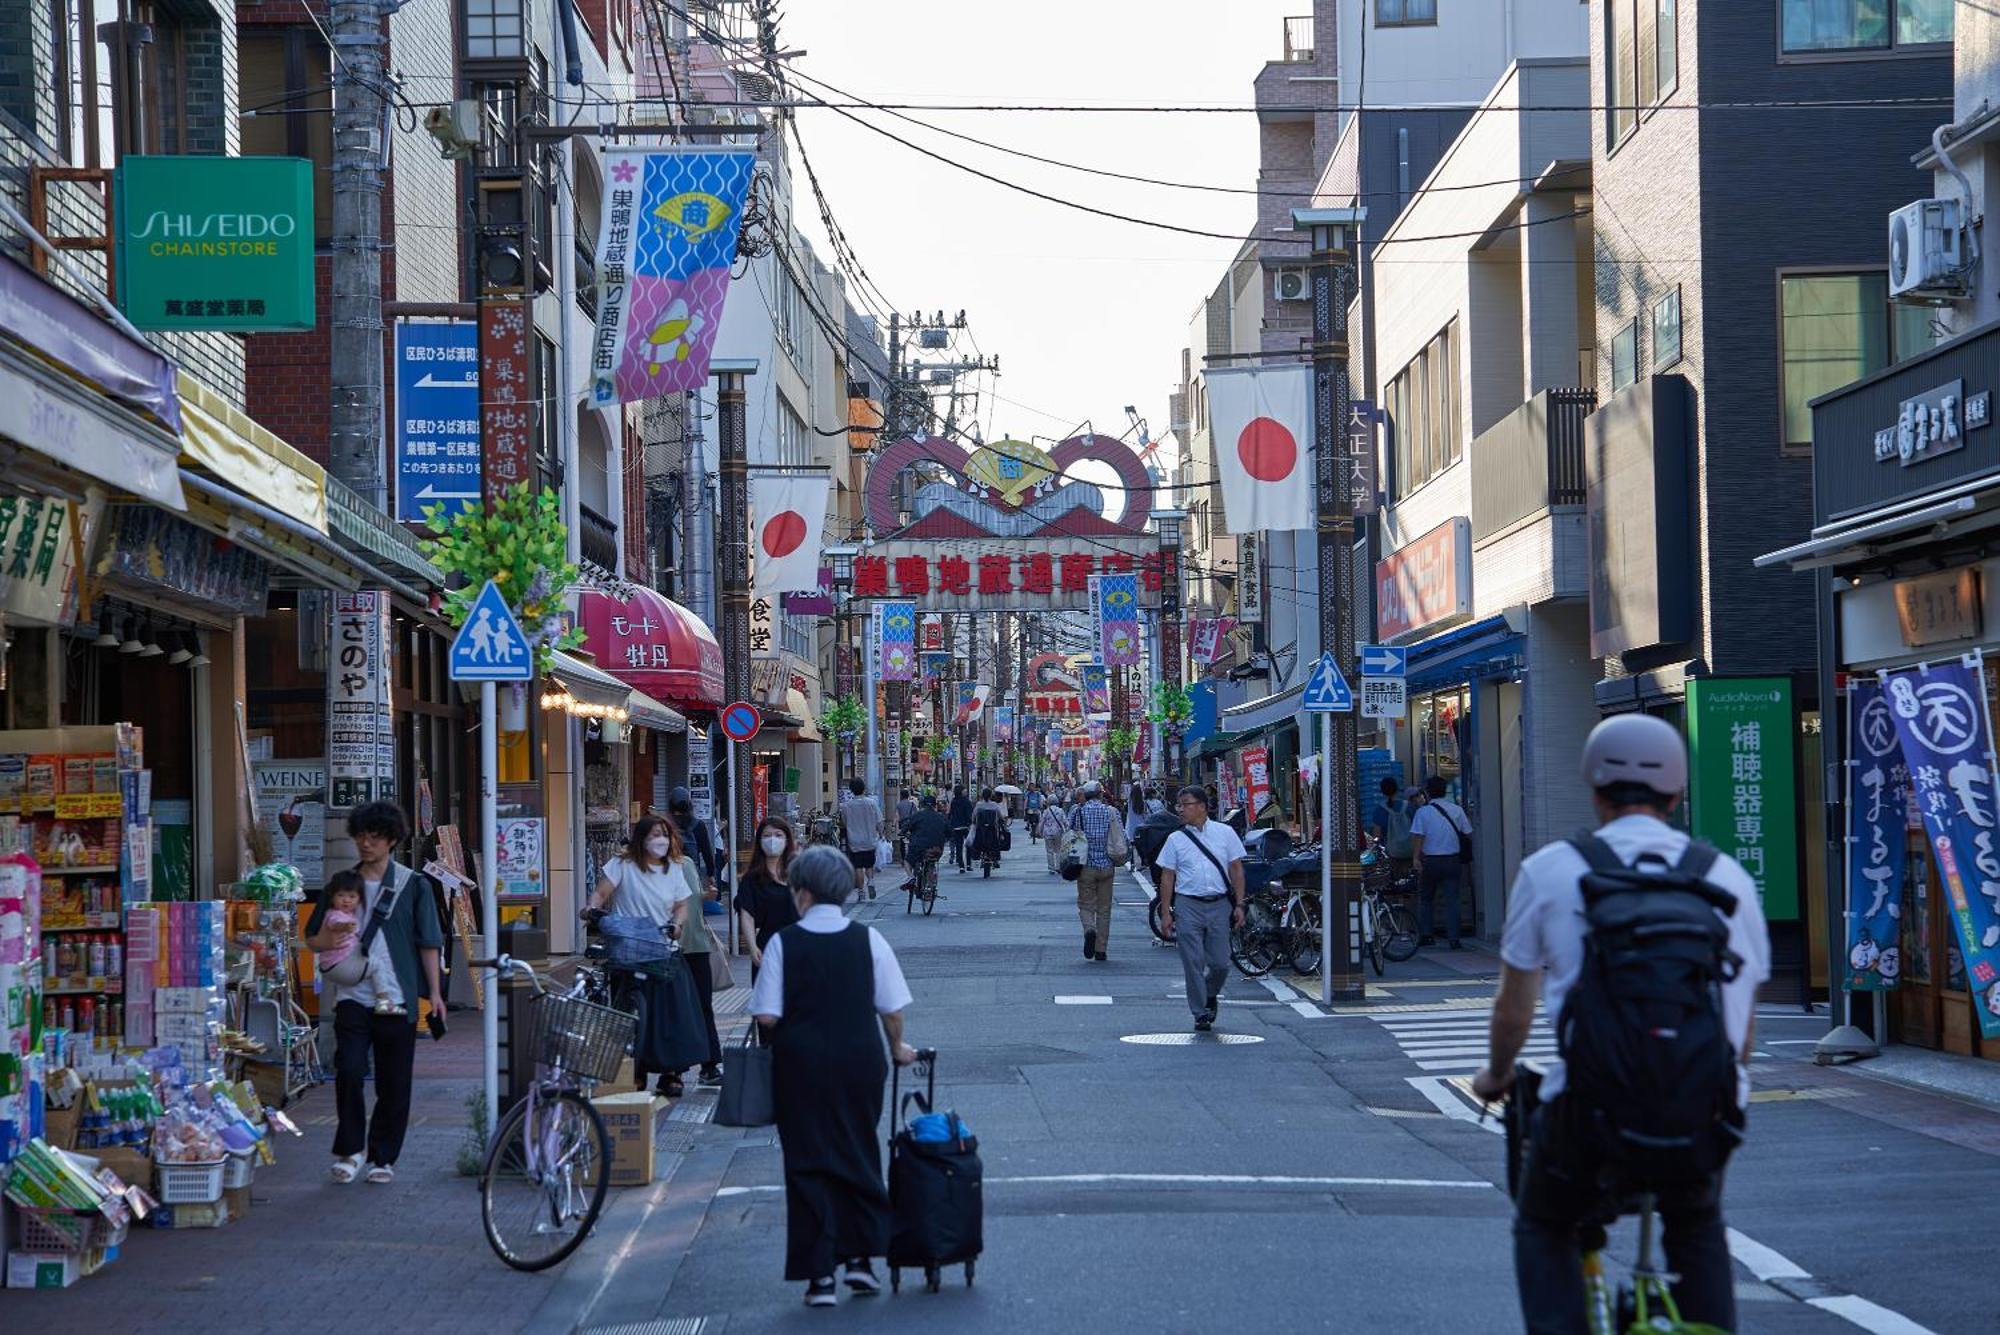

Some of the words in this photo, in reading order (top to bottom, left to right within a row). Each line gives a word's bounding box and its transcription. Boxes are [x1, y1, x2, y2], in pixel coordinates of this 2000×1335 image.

[130, 211, 296, 238] SHISEIDO
[150, 242, 278, 256] CHAINSTORE
[595, 189, 633, 370] 巣鴨地蔵通り商店街
[406, 347, 479, 361] 区民ひろば清和
[1349, 406, 1369, 509] 大正大学
[612, 616, 660, 636] モード
[341, 617, 367, 696] さのや
[626, 643, 668, 667] 牡丹
[1709, 691, 1768, 703] AudioNova
[261, 771, 324, 786] WEINE
